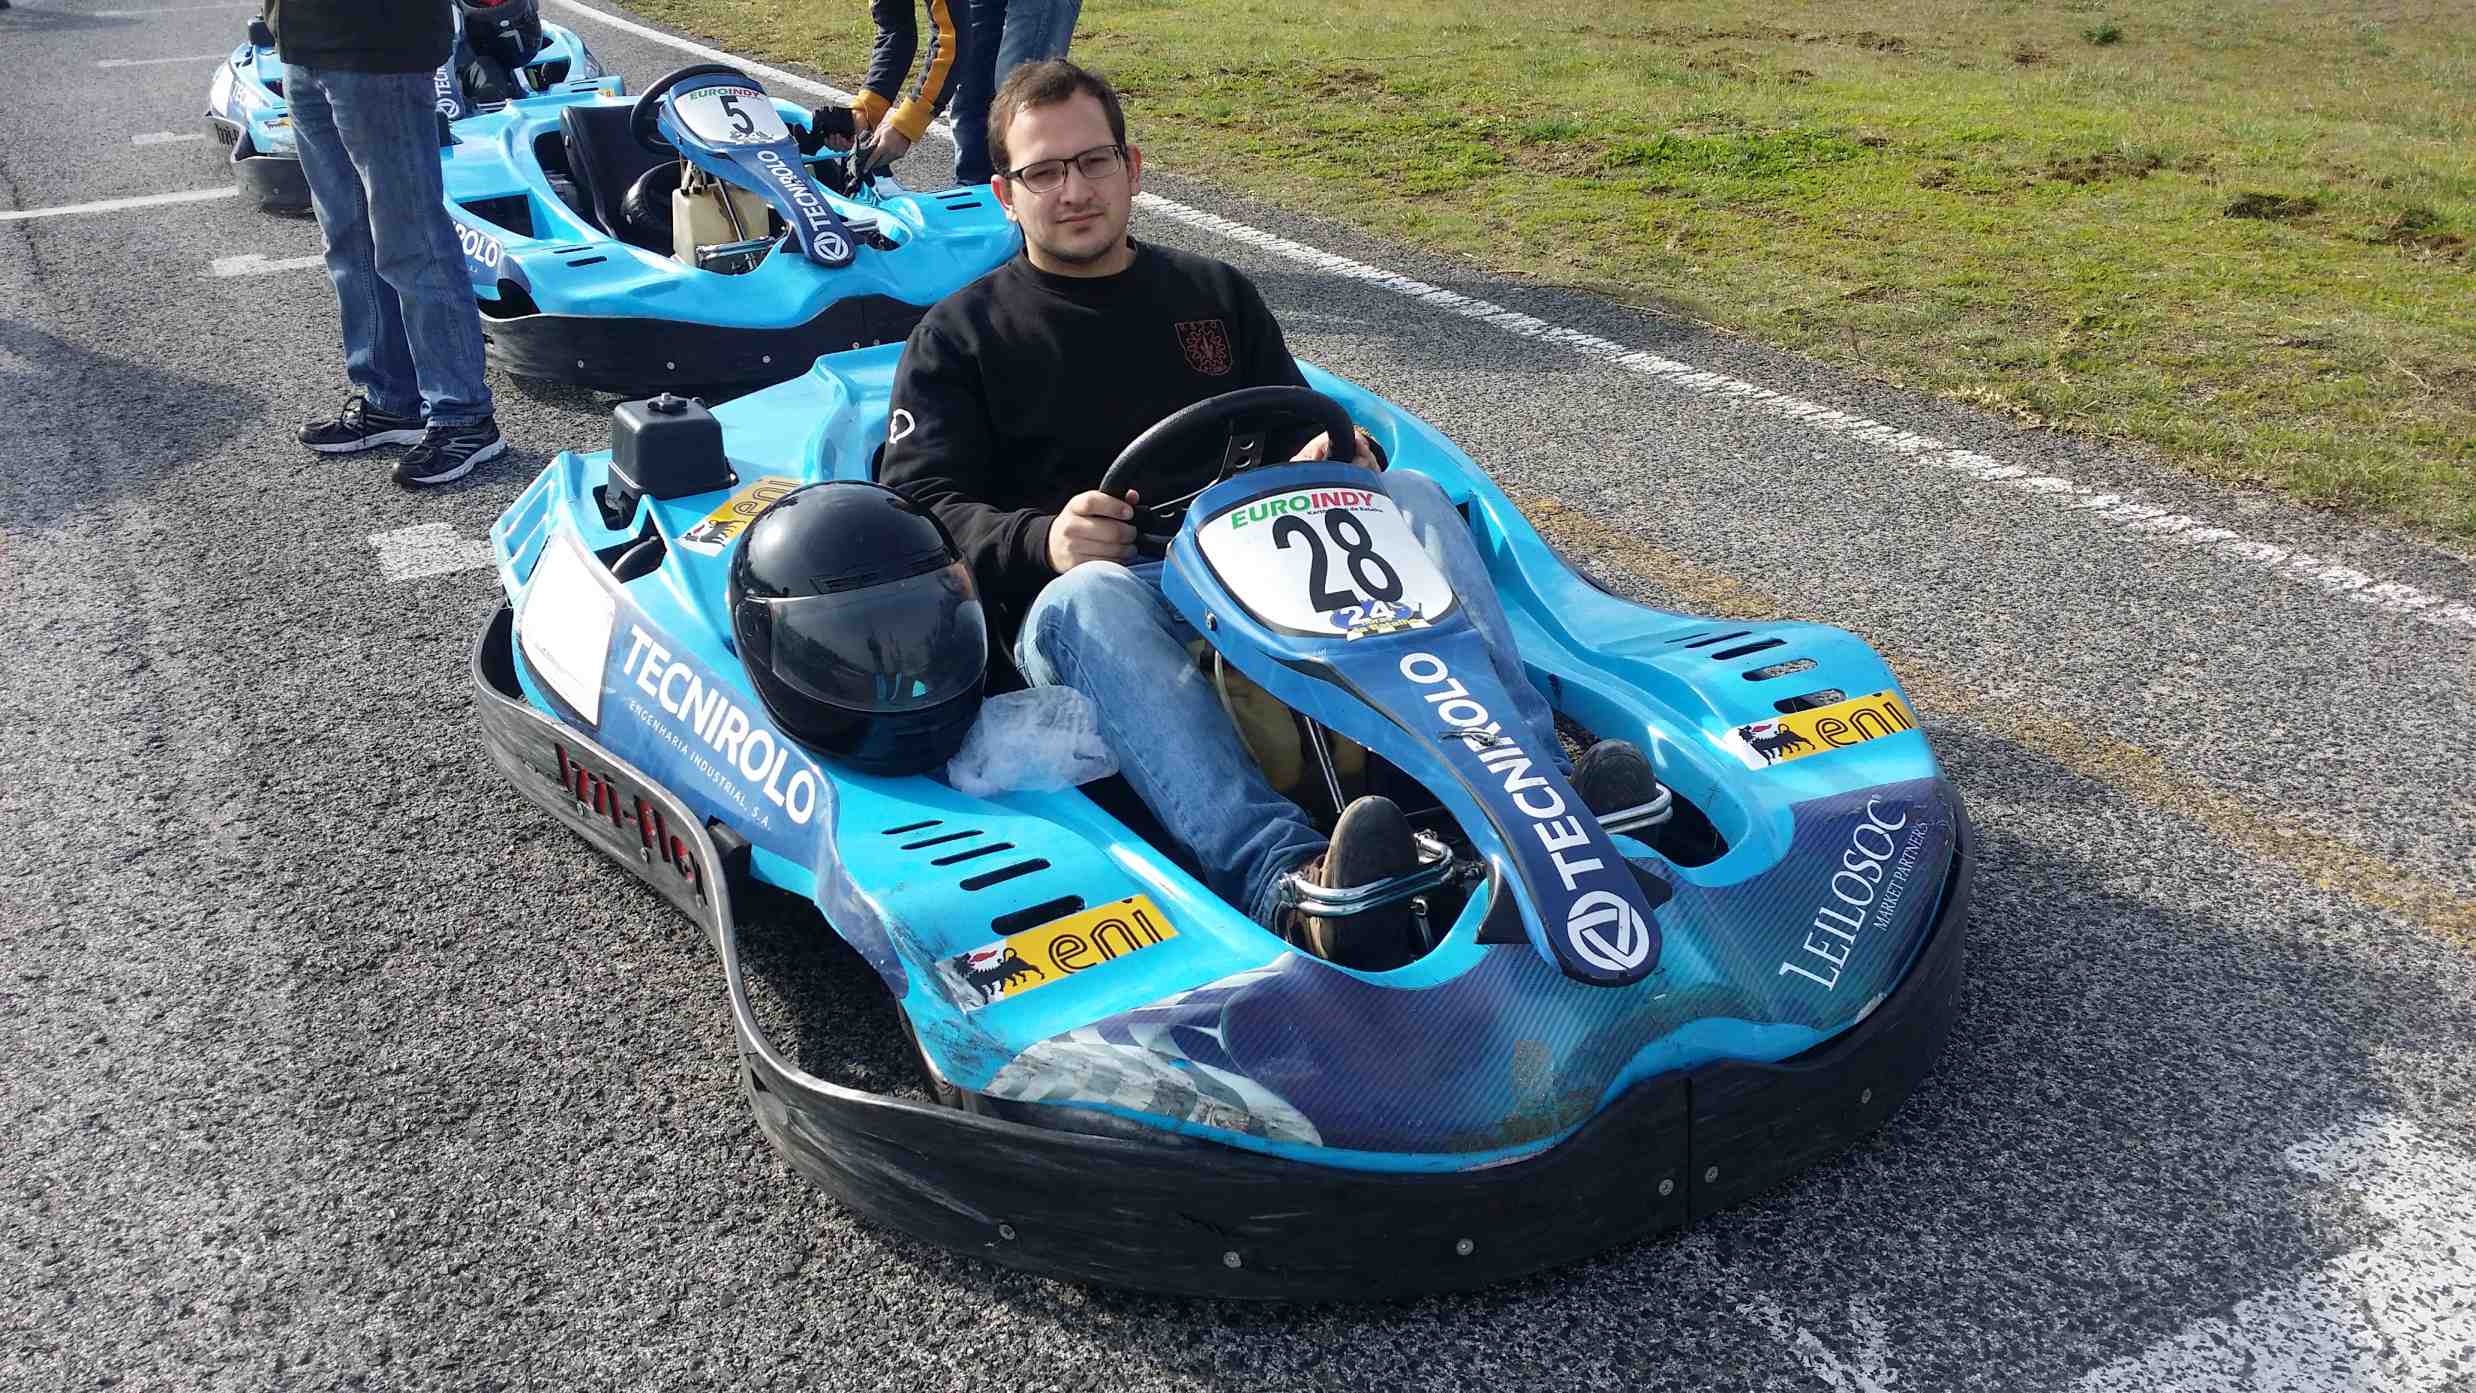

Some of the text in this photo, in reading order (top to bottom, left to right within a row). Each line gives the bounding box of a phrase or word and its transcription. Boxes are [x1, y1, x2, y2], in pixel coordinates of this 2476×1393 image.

[688, 87, 761, 100] EUROINDY
[719, 96, 754, 136] 5
[757, 150, 832, 232] TECNIROLO
[1231, 491, 1376, 530] EUROINDY
[1272, 508, 1404, 613] 28
[1340, 600, 1397, 627] 24
[623, 624, 816, 825] TECNIROLO
[629, 699, 688, 756] ENGENHARIA
[1815, 692, 1913, 748] eni
[1399, 652, 1604, 891] TECNIROLO
[1778, 797, 1906, 991] LEILOSOC
[1873, 822, 1929, 932] MARKET PARTNERS
[1048, 897, 1163, 974] eni
